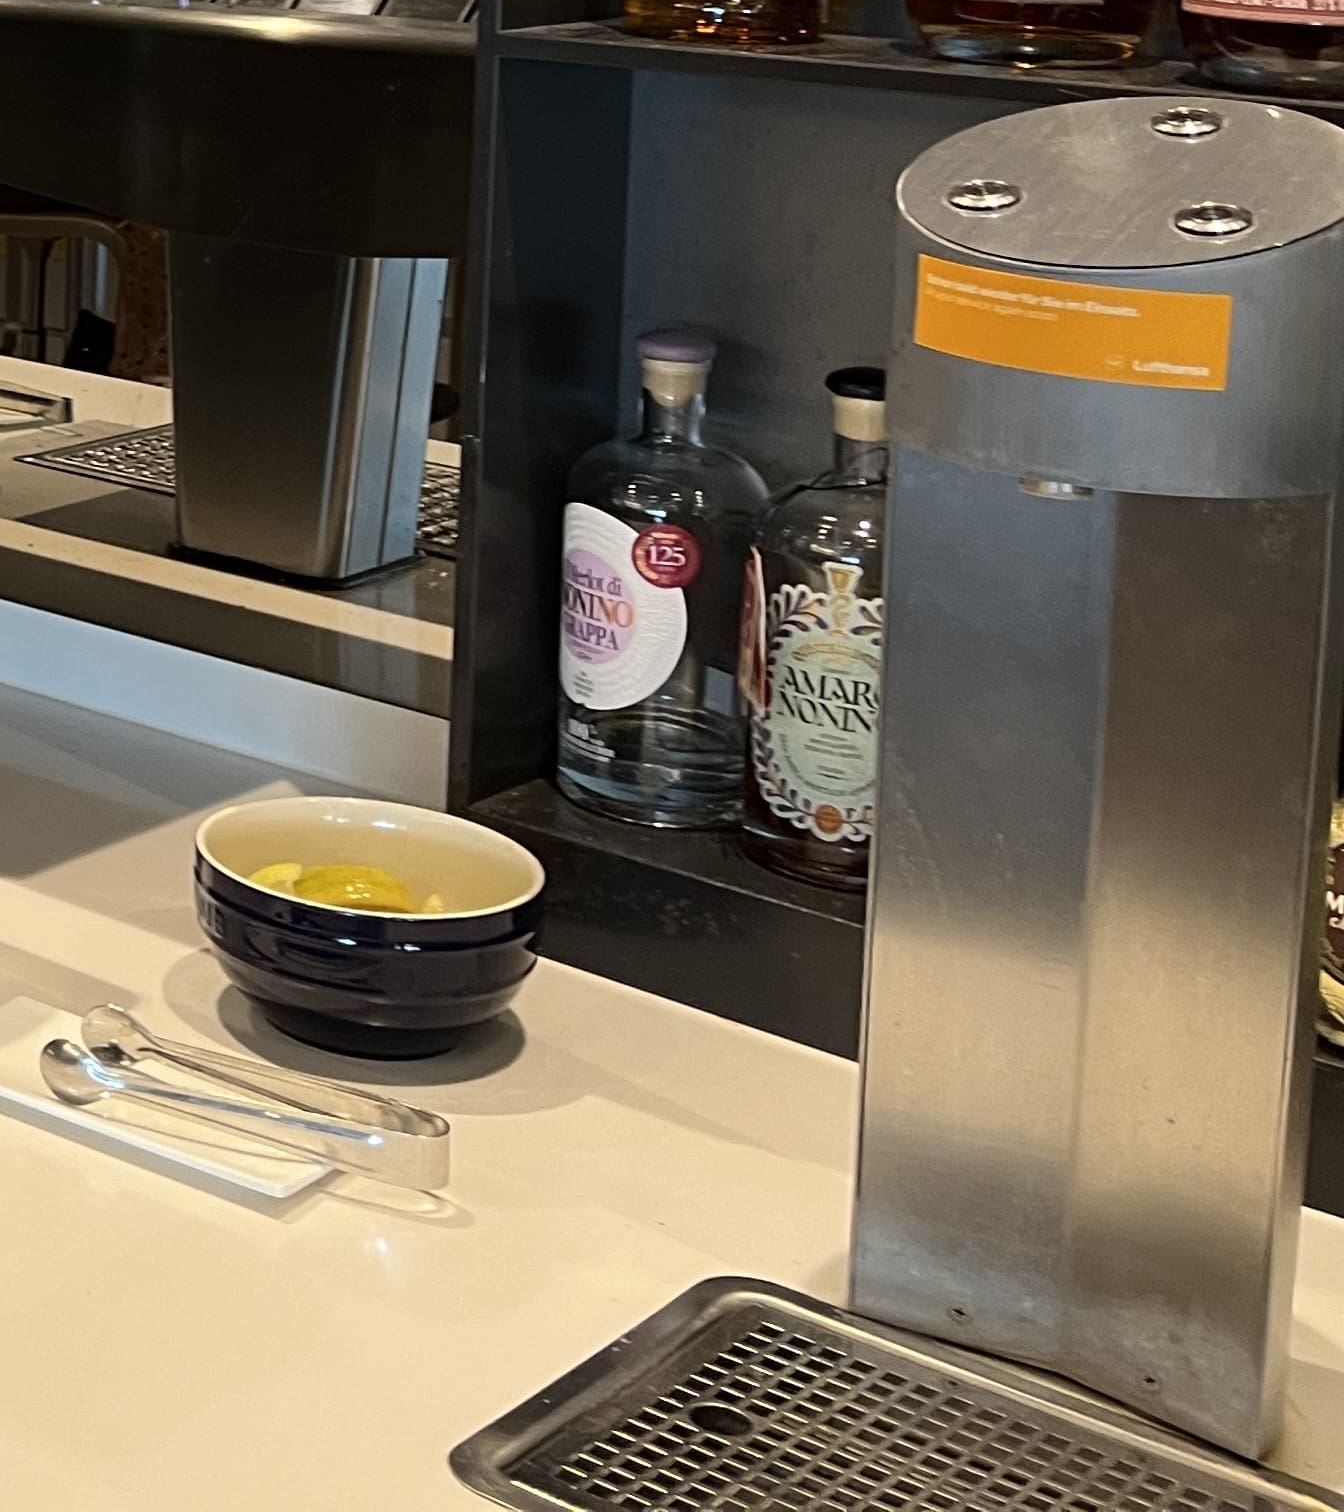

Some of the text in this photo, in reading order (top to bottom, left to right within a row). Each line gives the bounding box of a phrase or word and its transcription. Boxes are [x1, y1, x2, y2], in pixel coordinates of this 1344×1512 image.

[564, 584, 634, 628] ONINO
[564, 614, 619, 651] RAPPA
[780, 664, 880, 710] AMAR
[776, 688, 873, 733] NONIN
